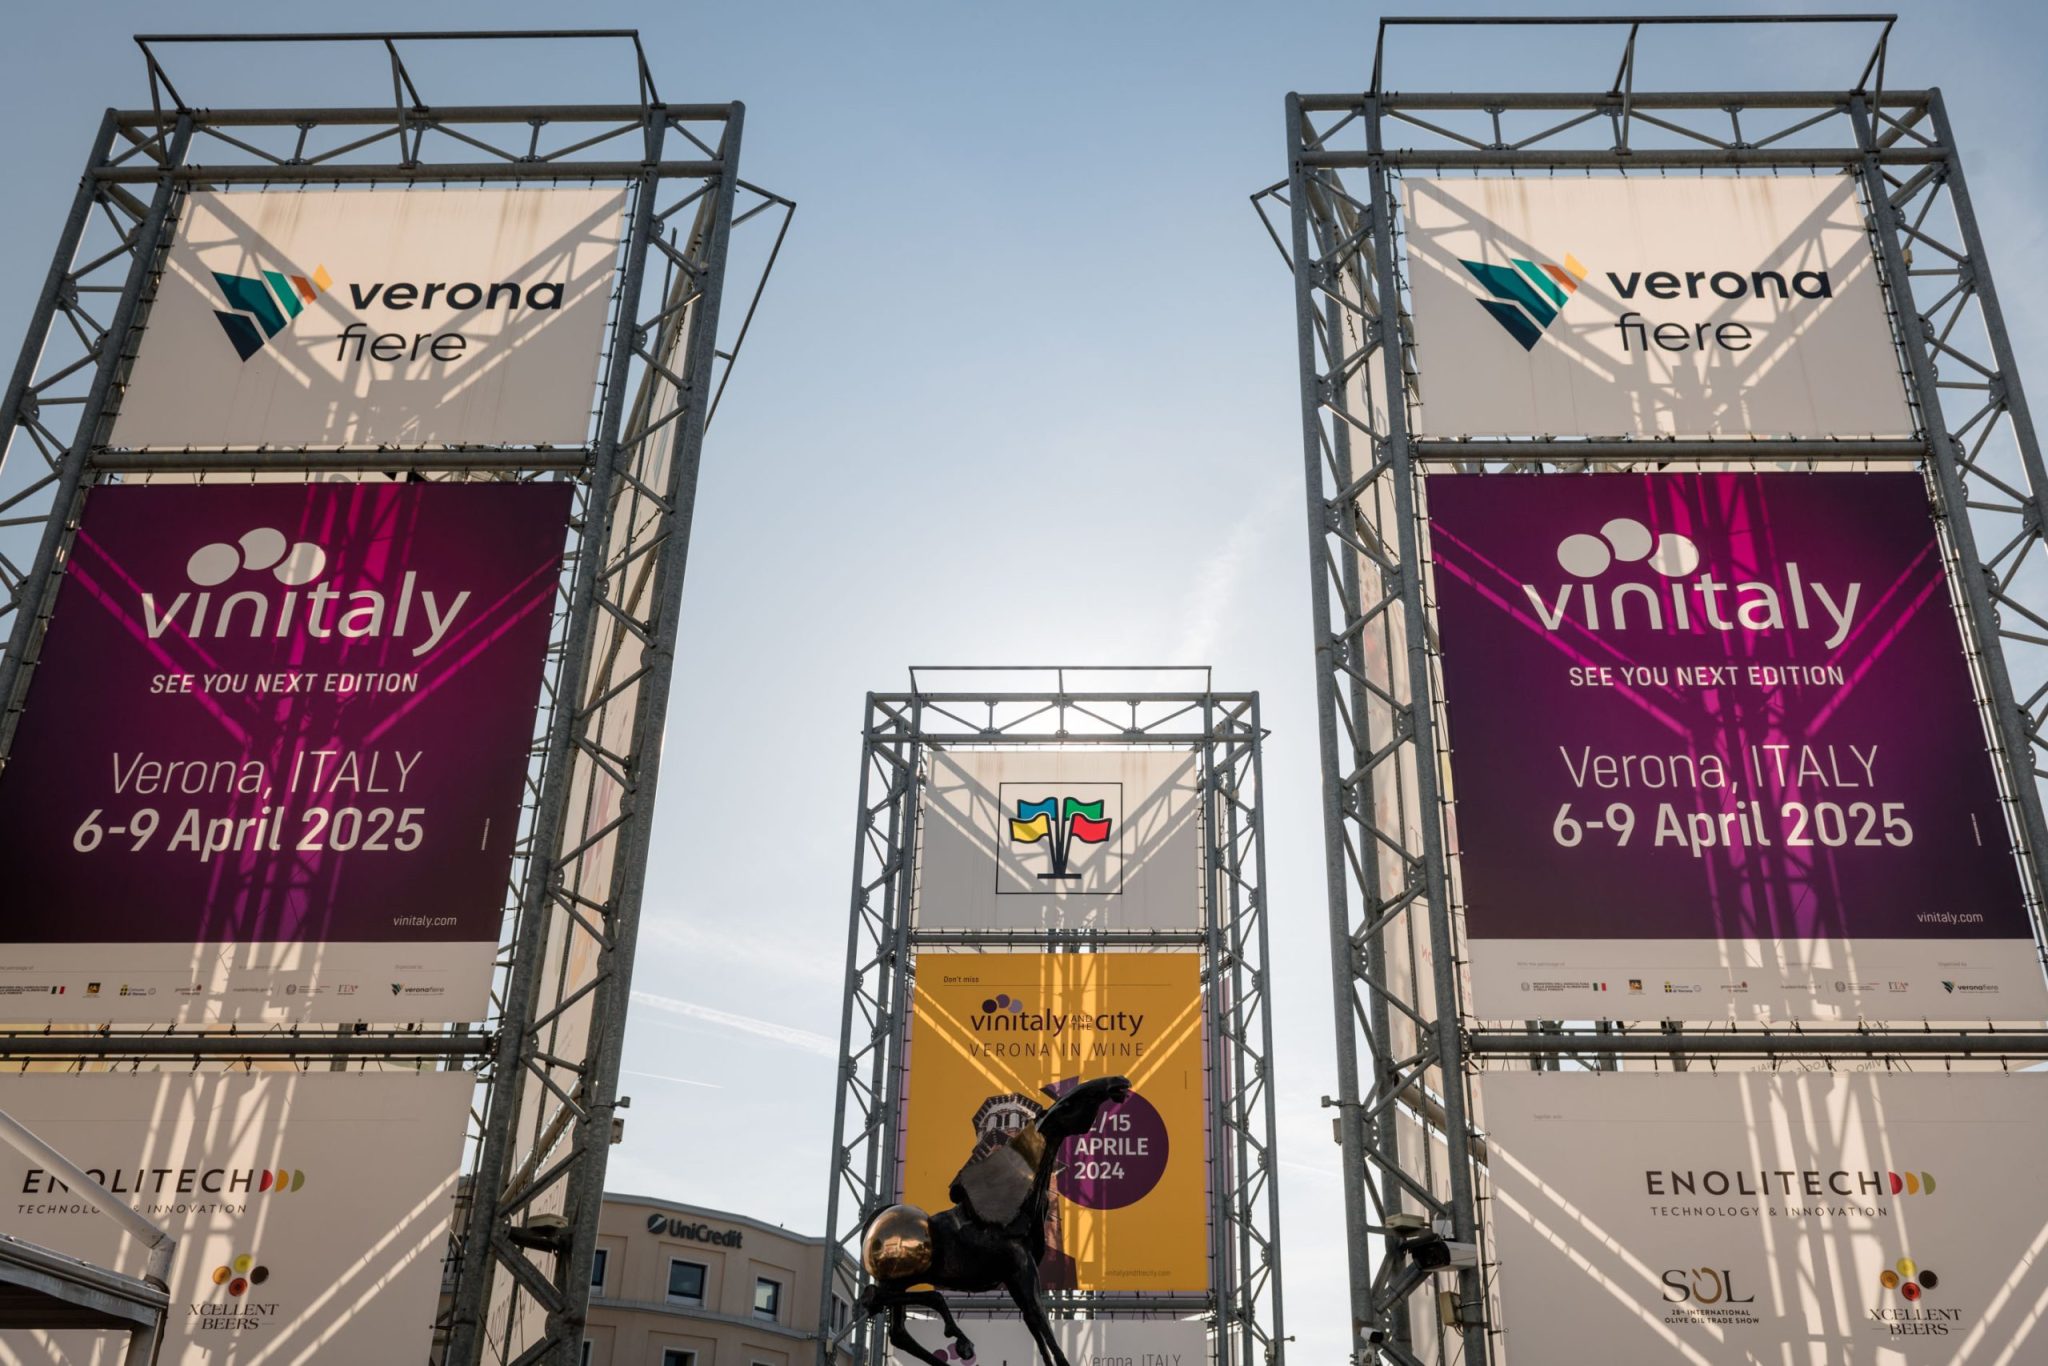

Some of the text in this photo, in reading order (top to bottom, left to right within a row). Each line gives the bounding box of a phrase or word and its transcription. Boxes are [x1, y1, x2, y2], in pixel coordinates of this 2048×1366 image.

[349, 281, 564, 311] verona
[1606, 271, 1833, 299] verona
[335, 323, 467, 362] fiere
[1614, 312, 1752, 352] fiere
[141, 571, 471, 657] vinitaly
[1522, 562, 1861, 649] vinitaly
[150, 672, 418, 694] SEE YOU NEXT EDITION
[1569, 666, 1845, 687] SEE YOU NEXT EDITION
[112, 751, 424, 800] Verona, ITALY
[1559, 744, 1878, 795] Verona, ITALY
[72, 806, 425, 862] 6-9 April 2025
[1552, 801, 1914, 857] 6-9 April 2025
[393, 915, 457, 928] vinitaly.com
[1917, 911, 1983, 925] vinitaly.com
[970, 1008, 1144, 1037] vinitaly AND THE city
[969, 1043, 1145, 1057] VERONA IN WINE
[1089, 1111, 1132, 1134] /15
[1074, 1137, 1149, 1156] APRILE
[1074, 1161, 1125, 1180] 2024
[1645, 1170, 1884, 1196] ENOLITECH
[147, 1204, 247, 1214] INNOVATION
[1650, 1206, 1888, 1217] TECHNOLOGY & INNOVATION
[669, 1219, 742, 1248] UniCredit
[1662, 1267, 1755, 1304] SOL
[187, 1303, 280, 1317] XCELLENT
[1869, 1308, 1963, 1321] XCELLENT
[201, 1316, 260, 1330] BEERS
[1889, 1323, 1949, 1336] BEERS
